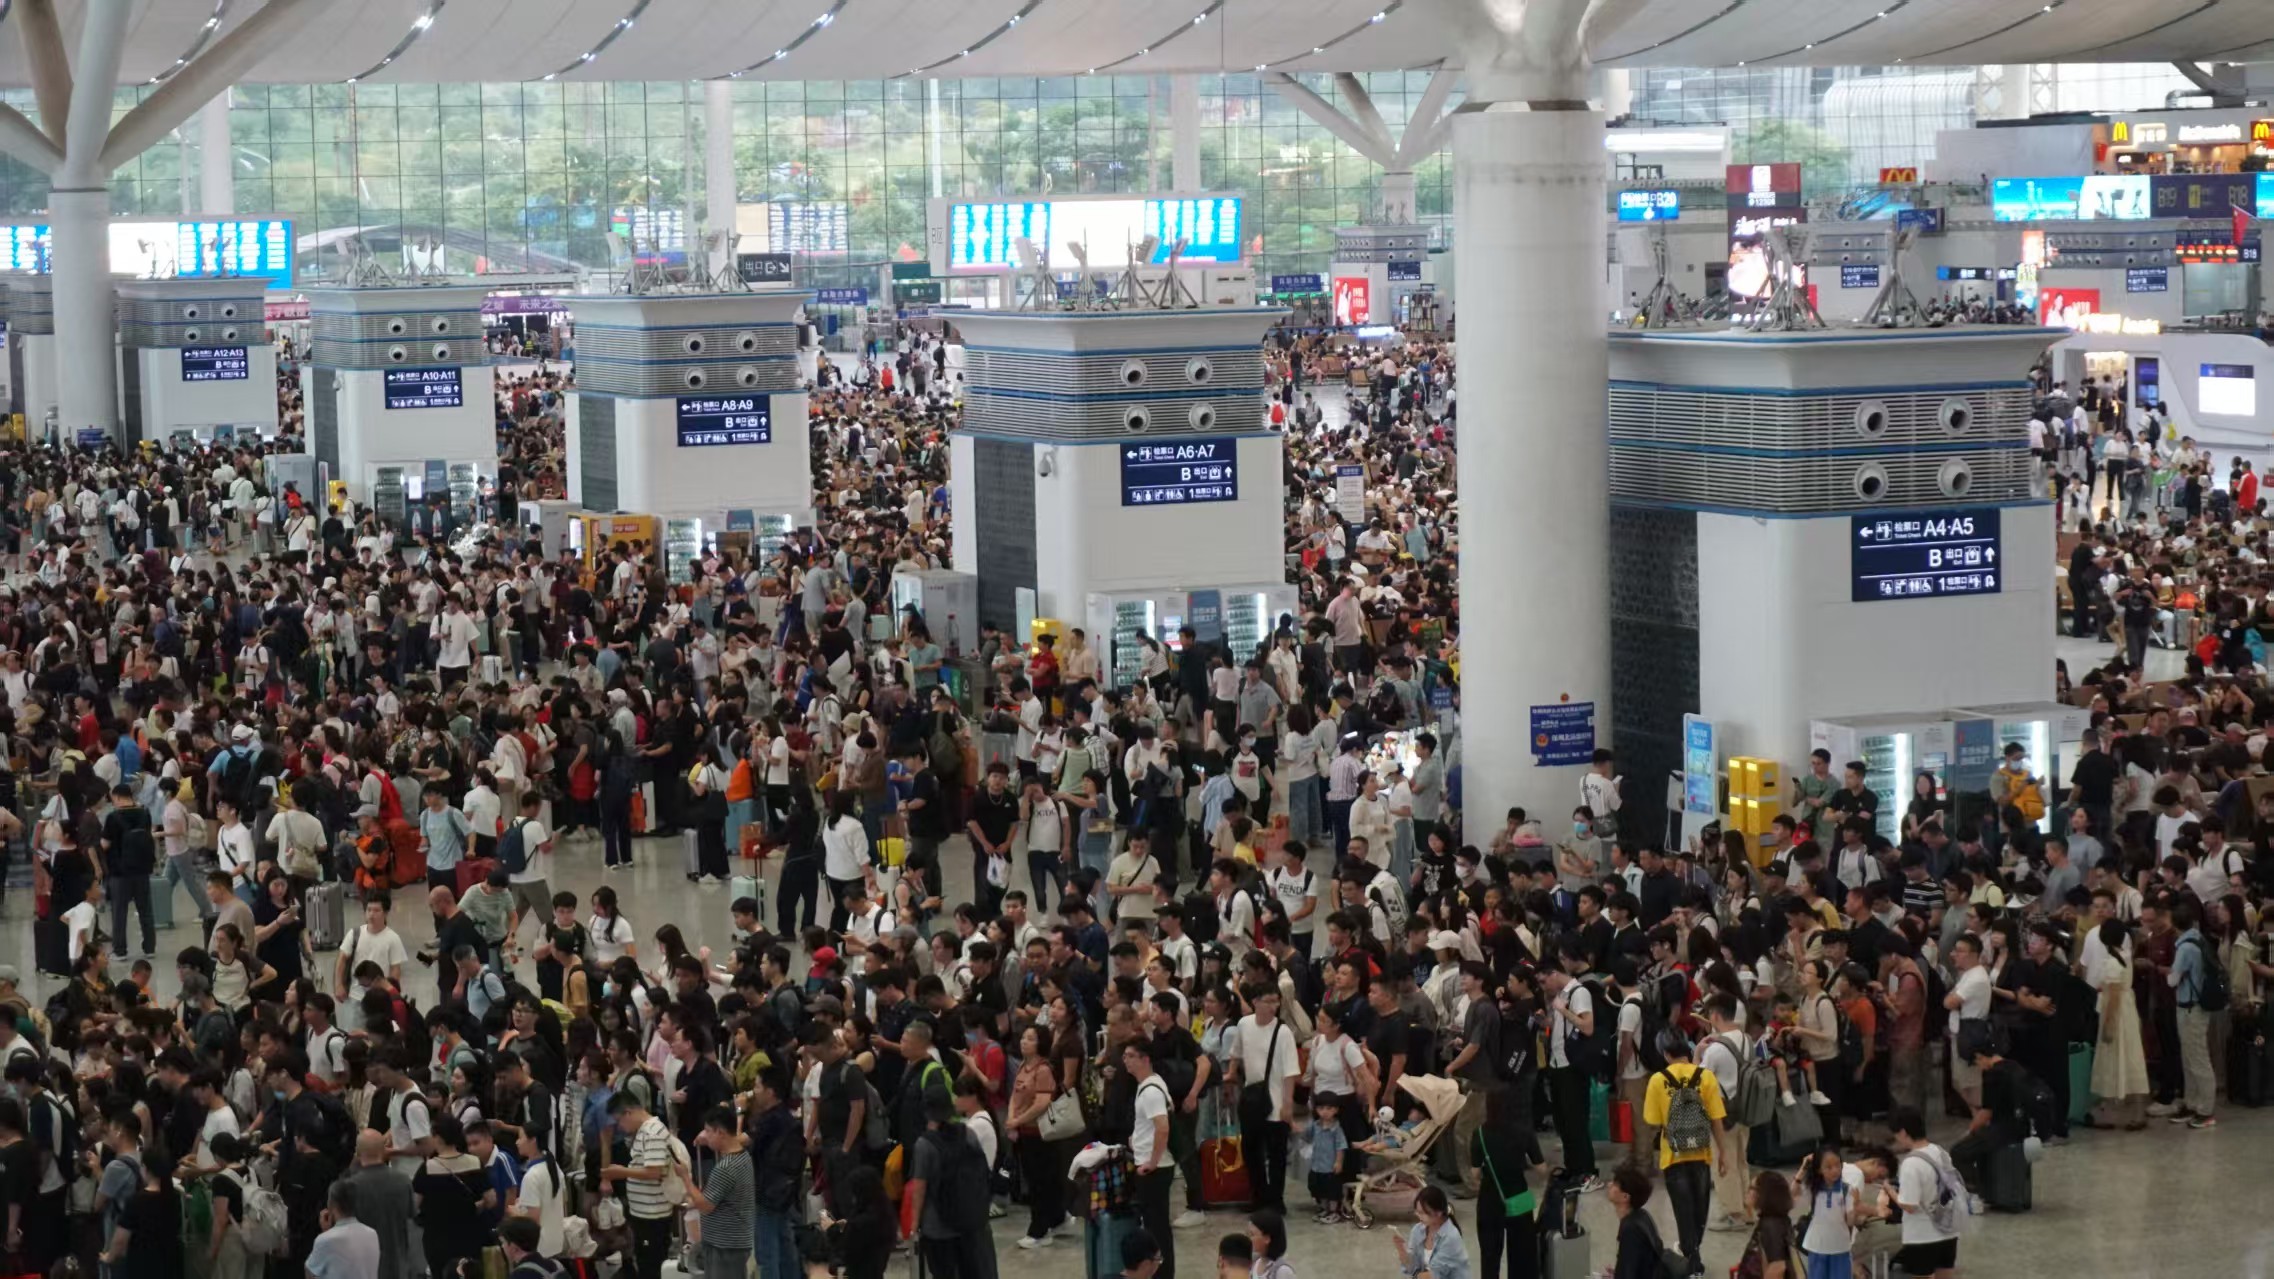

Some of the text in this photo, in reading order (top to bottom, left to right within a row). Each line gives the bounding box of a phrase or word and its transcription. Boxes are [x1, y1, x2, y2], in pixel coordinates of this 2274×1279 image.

[745, 260, 763, 271] 出口
[424, 385, 432, 395] B
[725, 416, 734, 428] B
[1181, 467, 1192, 481] B
[1929, 548, 1963, 567] B 出口
[1938, 577, 1946, 591] 1
